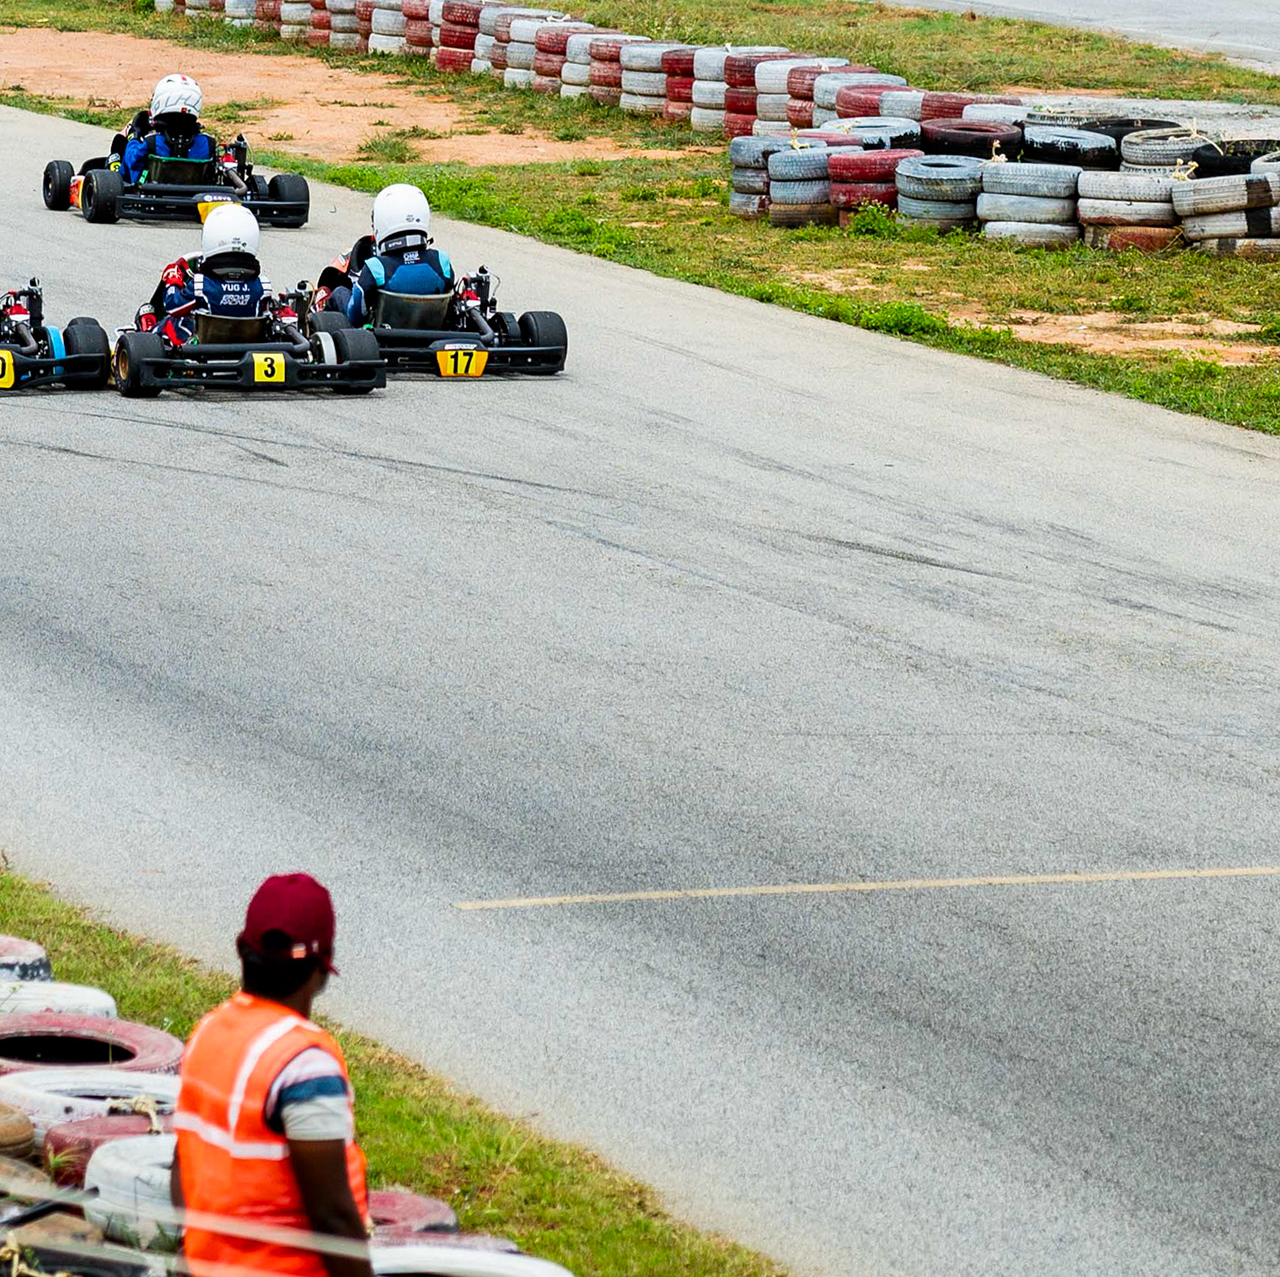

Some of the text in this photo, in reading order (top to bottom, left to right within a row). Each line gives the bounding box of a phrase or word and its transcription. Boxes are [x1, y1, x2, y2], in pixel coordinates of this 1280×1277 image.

[221, 283, 251, 292] YUG J.
[263, 357, 276, 378] 3
[450, 351, 474, 375] 17
